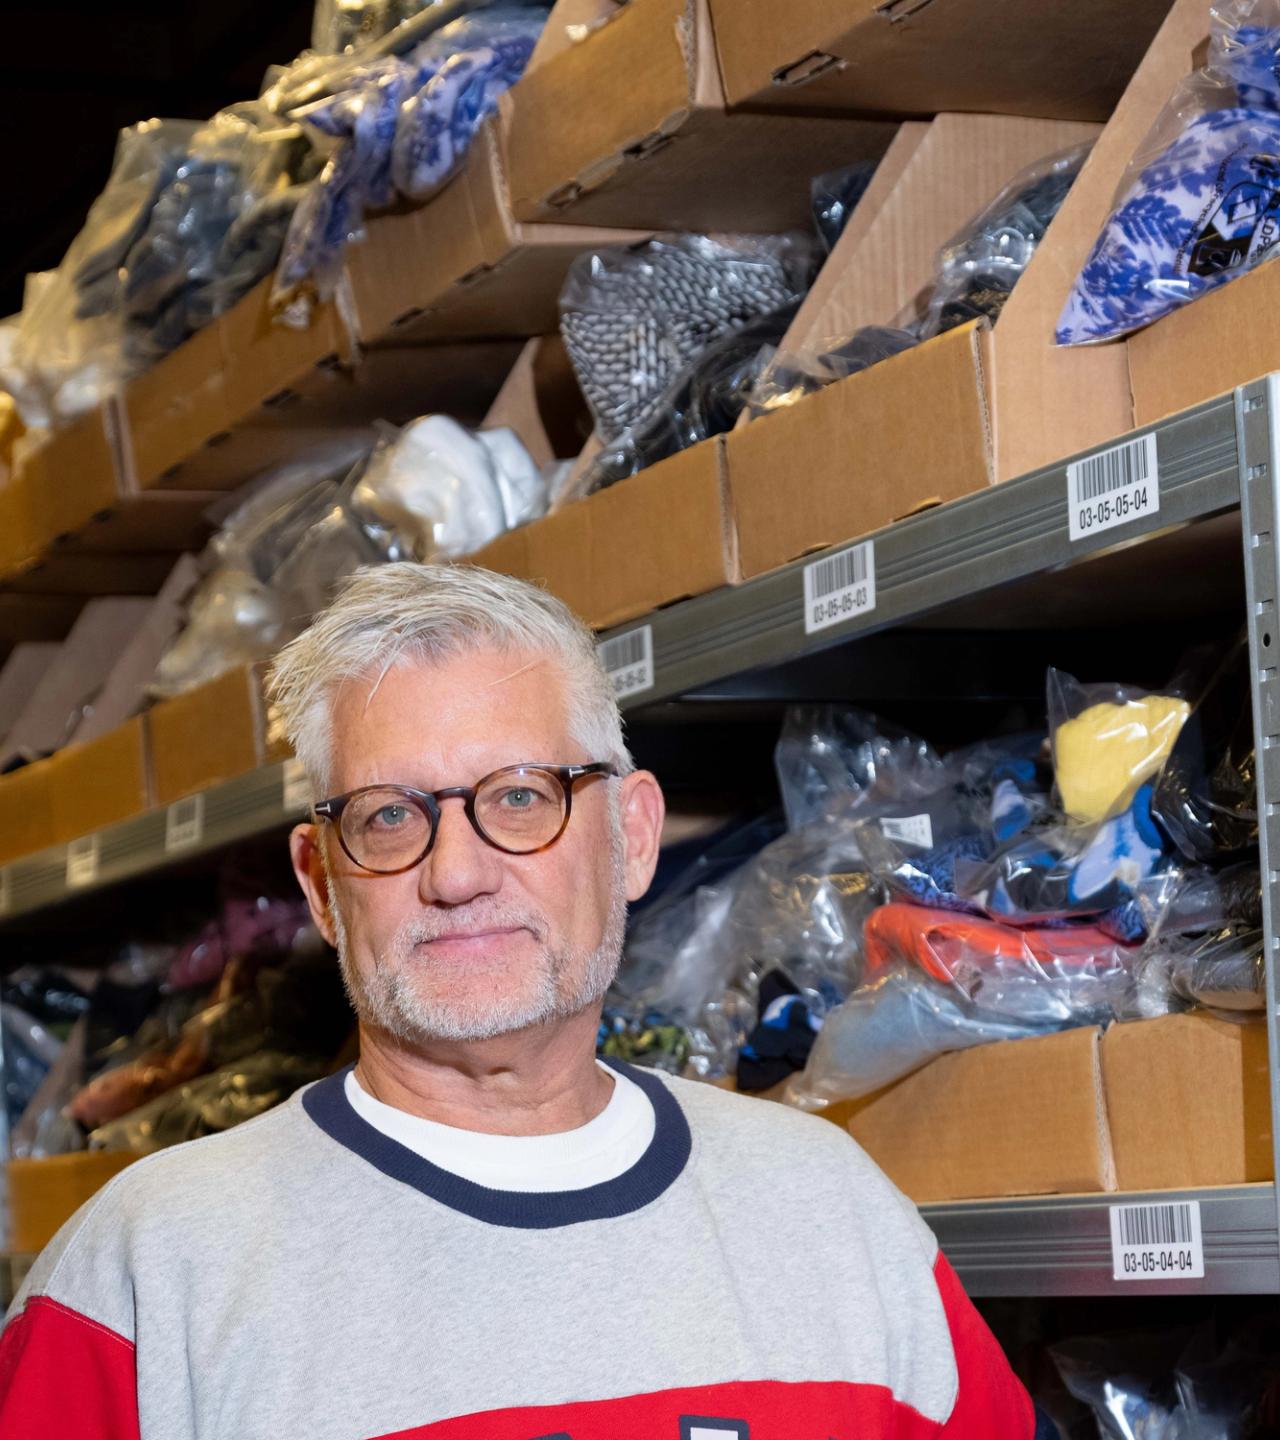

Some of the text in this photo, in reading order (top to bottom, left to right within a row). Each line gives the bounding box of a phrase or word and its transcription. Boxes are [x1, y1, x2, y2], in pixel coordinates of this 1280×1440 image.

[1079, 486, 1148, 530] 03-05-05-04
[813, 586, 867, 623] 03-05-05-03
[1123, 1250, 1192, 1273] 03-05-04-04
